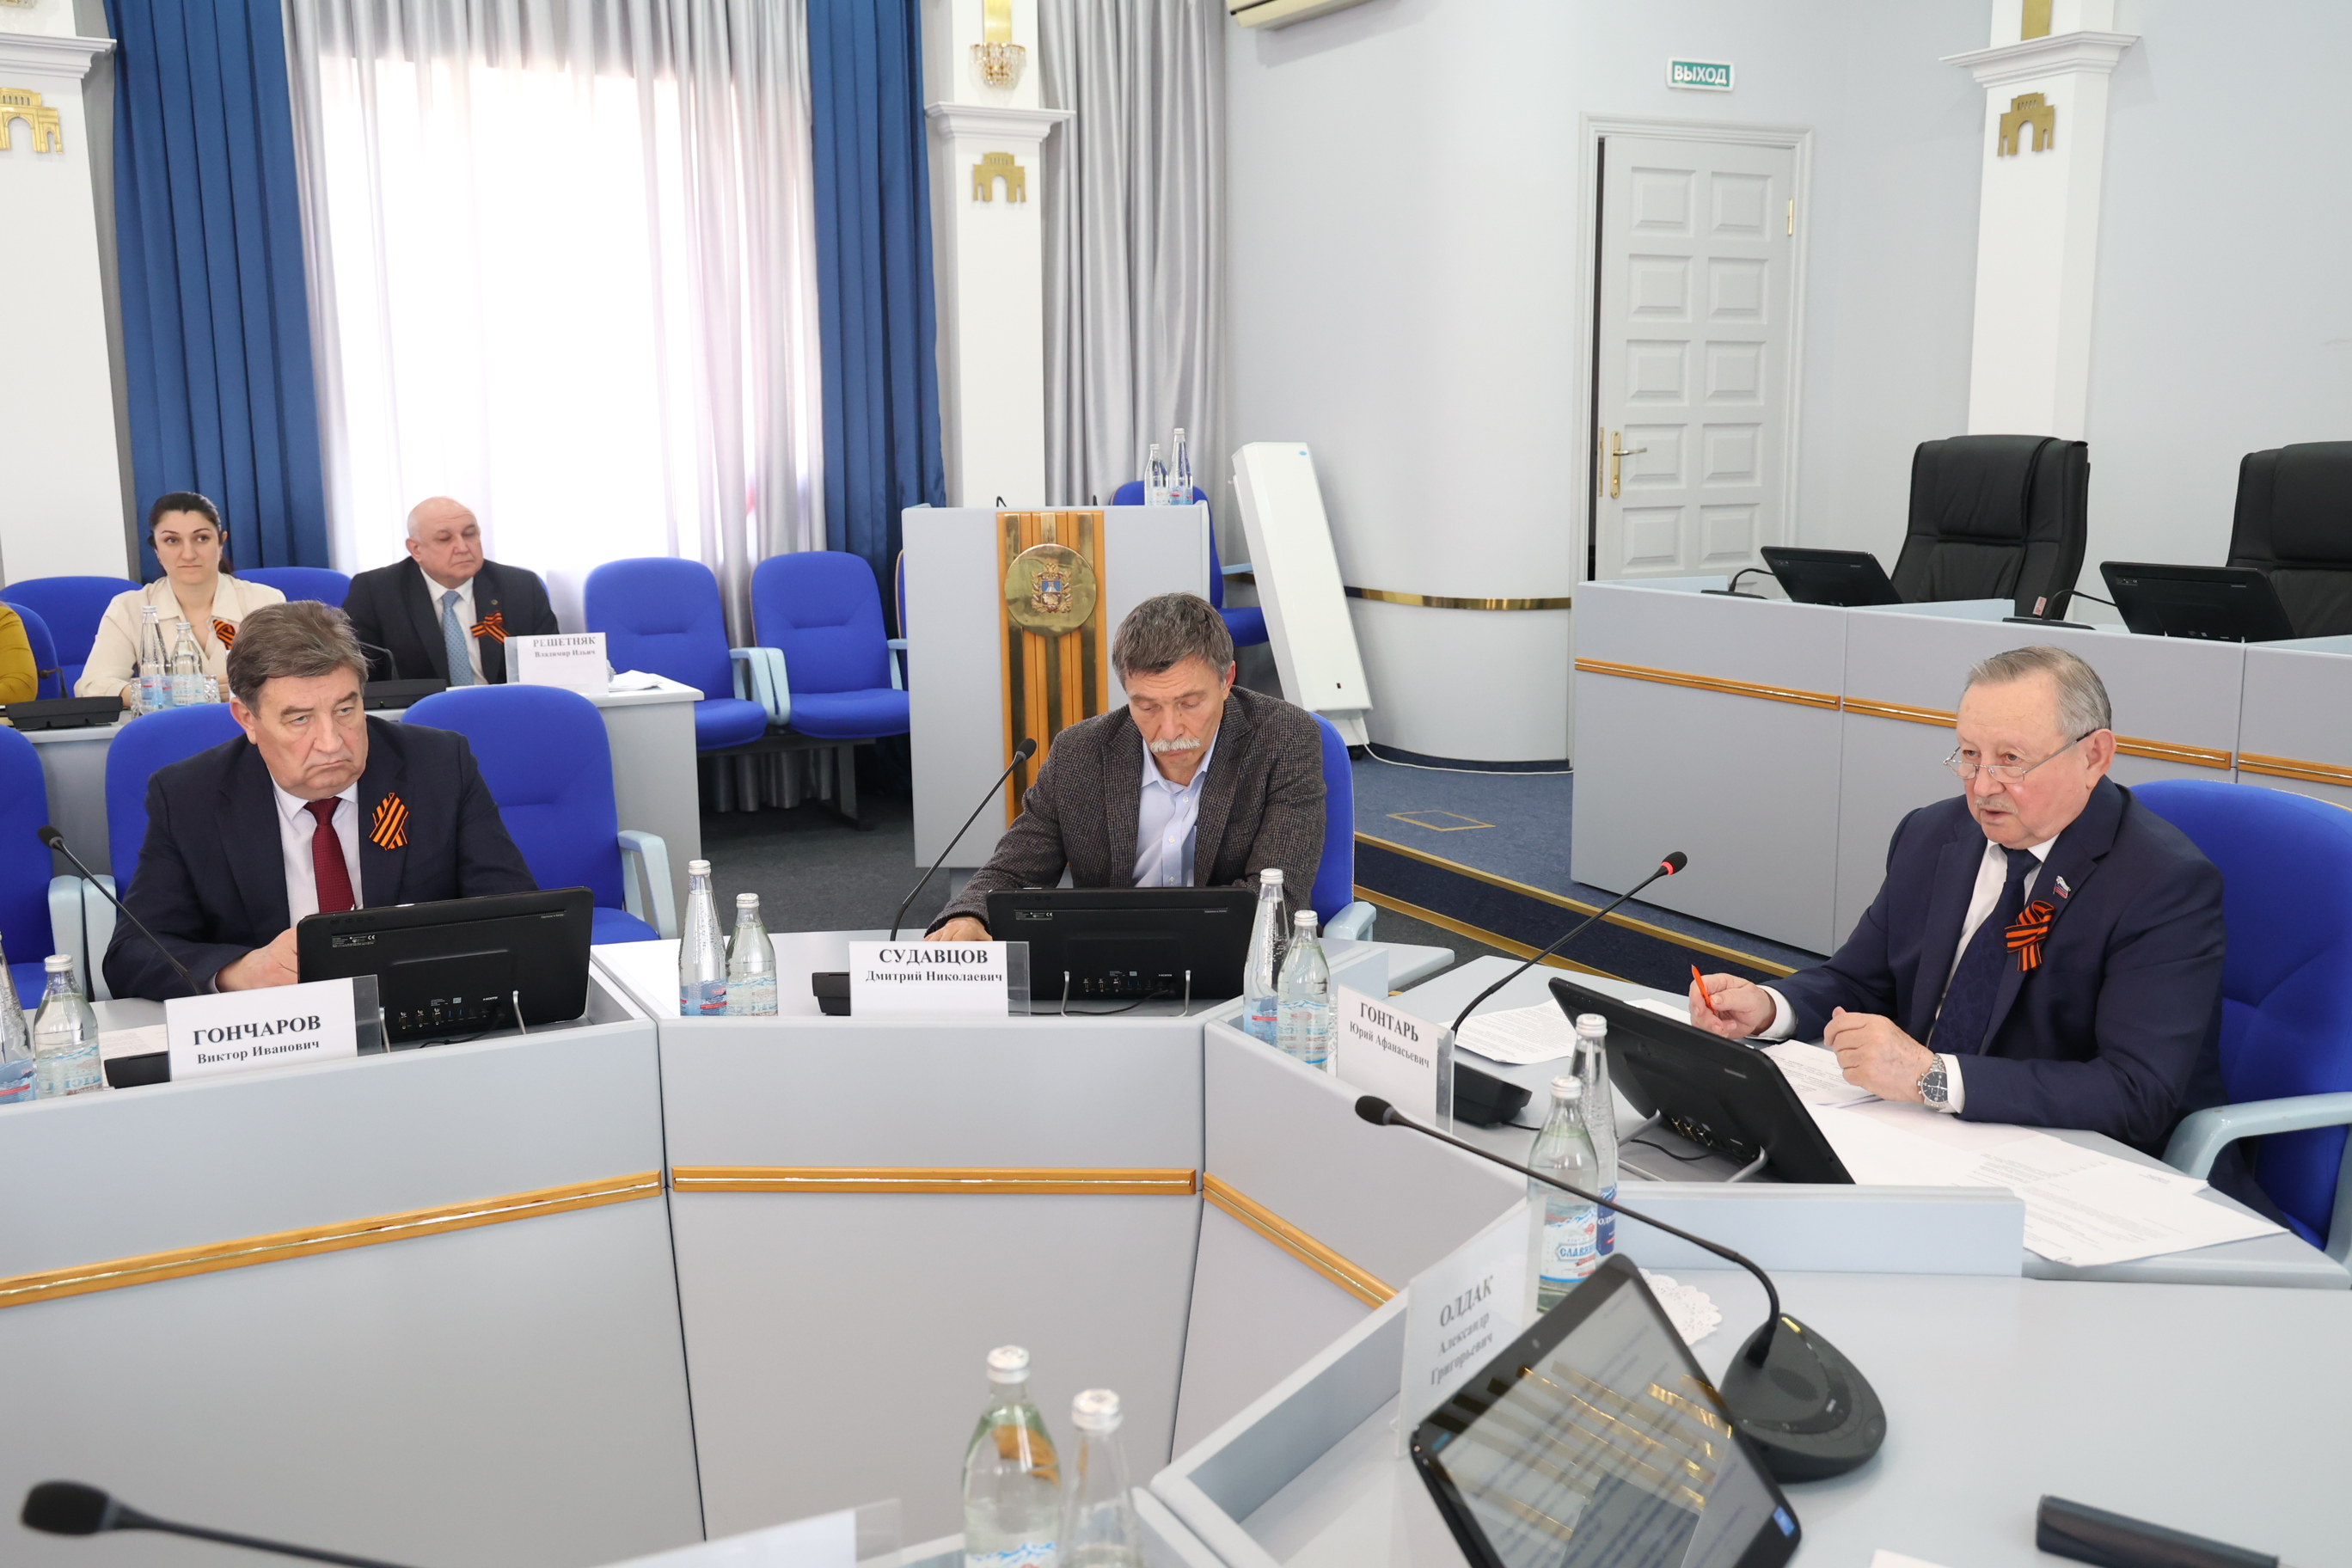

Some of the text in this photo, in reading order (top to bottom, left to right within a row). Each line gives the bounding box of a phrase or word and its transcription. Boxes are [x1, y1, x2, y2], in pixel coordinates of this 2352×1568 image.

[1674, 64, 1727, 84] ВЫХОД
[533, 636, 596, 647] РЕШЕТНЯК
[879, 948, 989, 966] СУДАВЦОВ
[866, 971, 1003, 983] Дмитрий Николаевич
[193, 1015, 322, 1046] ГОНЧАРОВ
[1360, 1001, 1419, 1042] ГОНТАРЬ
[197, 1040, 321, 1064] Виктор Иванович
[1350, 1021, 1430, 1069] Юрий Афанасьевич
[1440, 1275, 1493, 1326] ОЛДАК
[1437, 1313, 1489, 1357] Александр
[1431, 1332, 1492, 1385] Григорьевич
